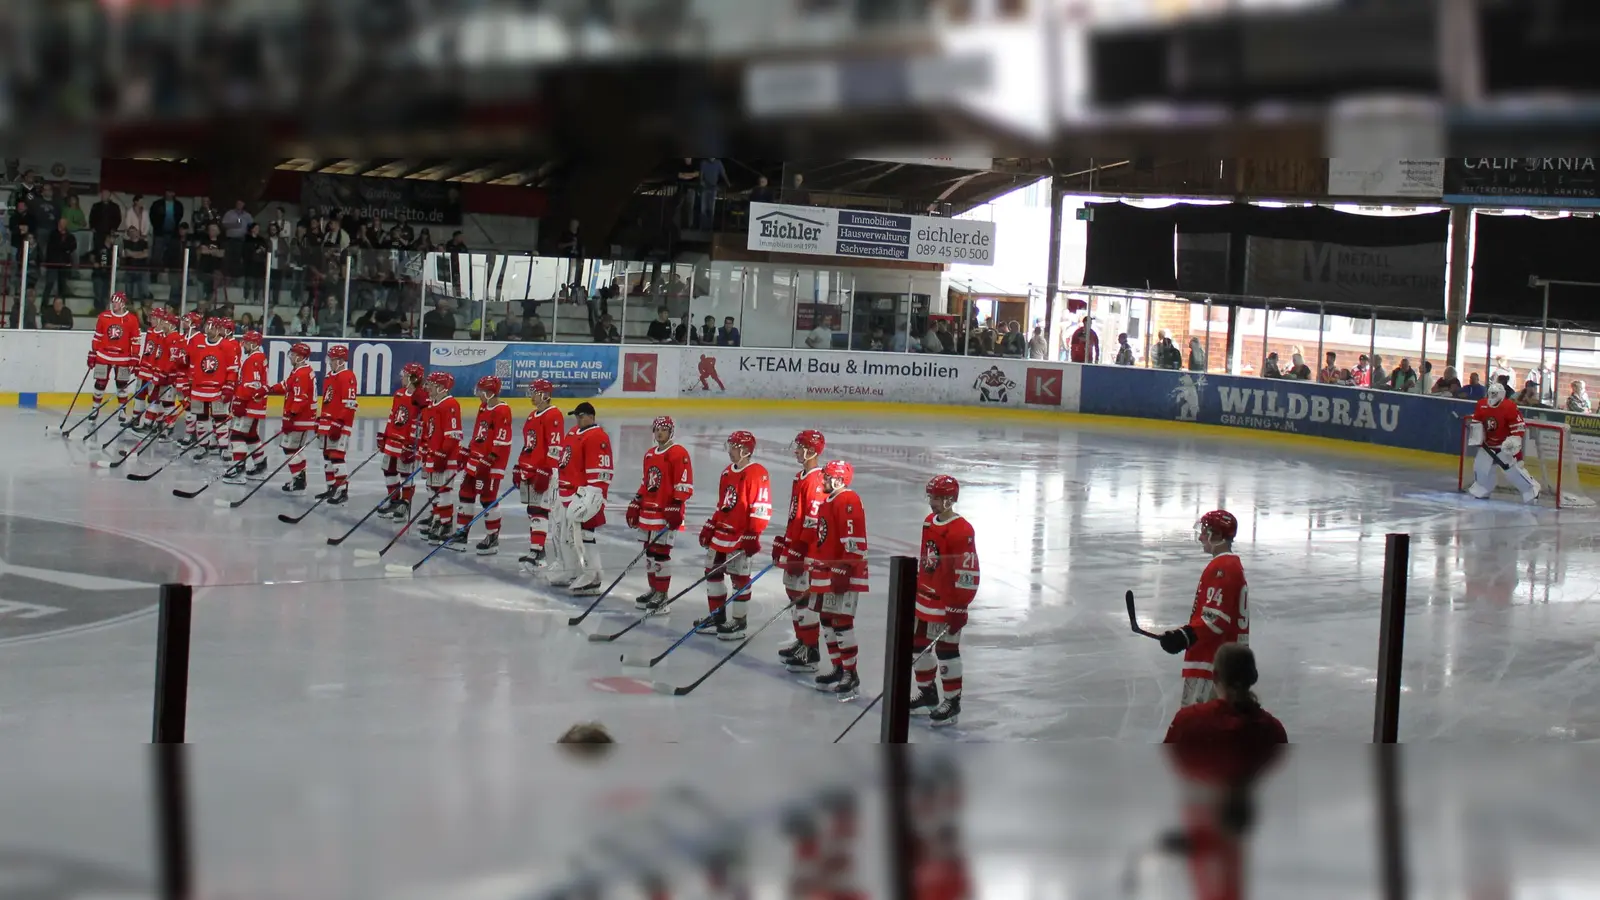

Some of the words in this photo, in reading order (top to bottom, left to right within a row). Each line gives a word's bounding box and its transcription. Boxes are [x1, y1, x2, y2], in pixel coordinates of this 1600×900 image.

[851, 214, 897, 228] Immobilien
[760, 219, 822, 241] Eichler
[840, 228, 908, 243] Hausverwaltung
[917, 226, 989, 246] eichler.de
[839, 243, 905, 258] Sachverständige
[916, 243, 936, 256] 089
[938, 245, 952, 257] 45
[953, 246, 967, 259] 50
[968, 248, 989, 260] 500
[516, 359, 537, 369] WIR
[539, 359, 578, 369] BILDEN
[581, 360, 603, 370] AUS
[739, 356, 802, 373] K-TEAM
[808, 358, 840, 374] Bau
[846, 359, 858, 375] &
[863, 360, 959, 378] Immobilien
[515, 370, 539, 379] UND
[541, 370, 588, 380] STELLEN
[590, 371, 612, 380] EIN!
[631, 362, 651, 384] K
[806, 384, 884, 397] www.K-TEAM.eu
[1035, 376, 1056, 397] K
[1217, 386, 1401, 433] WILDBRÄU
[451, 417, 457, 429] 8
[1220, 413, 1272, 429] GRAFING
[550, 431, 561, 445] 24
[598, 454, 610, 467] 30
[681, 468, 688, 482] 9
[758, 487, 769, 502] 14
[846, 519, 854, 535] 5
[962, 552, 978, 569] 21
[1206, 586, 1224, 607] 94
